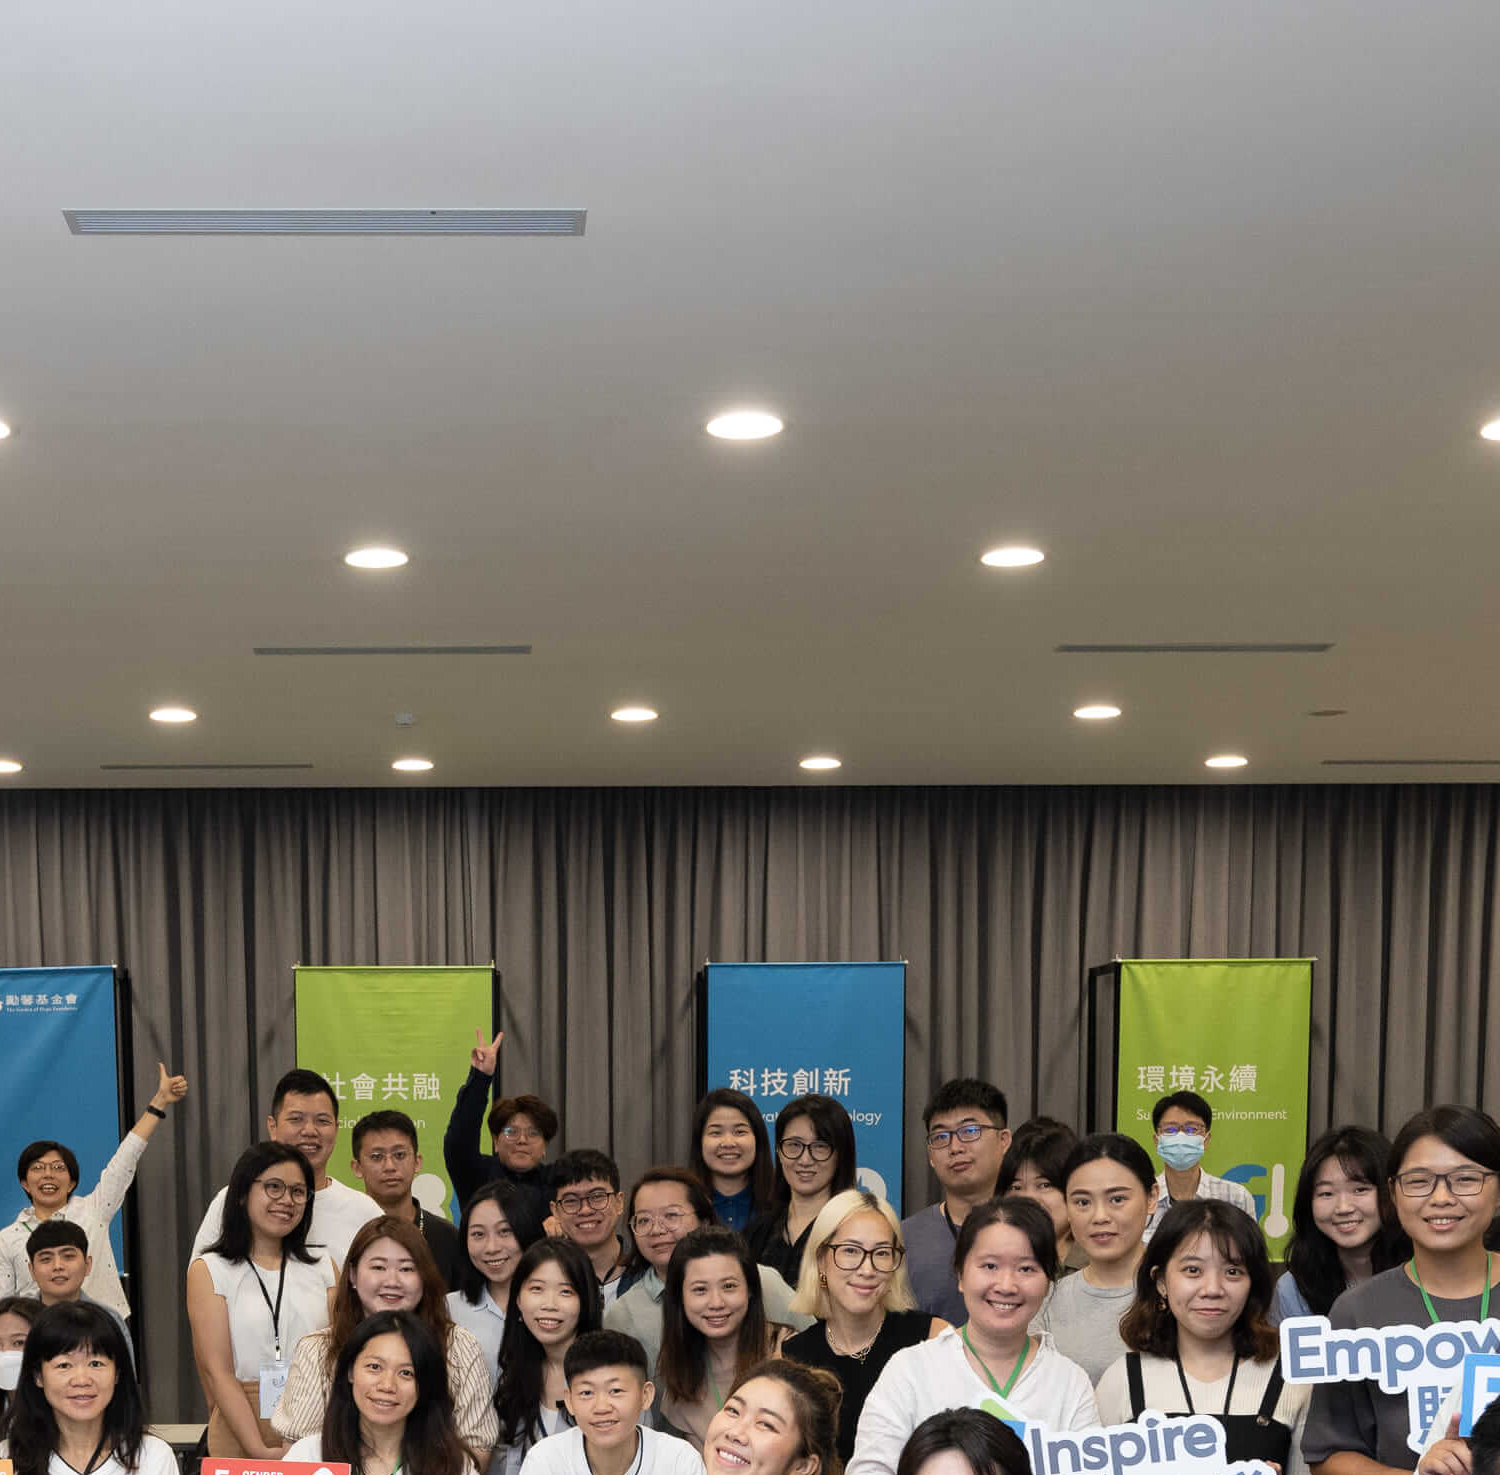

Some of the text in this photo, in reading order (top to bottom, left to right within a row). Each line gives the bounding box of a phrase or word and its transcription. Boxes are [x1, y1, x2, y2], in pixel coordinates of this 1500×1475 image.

[729, 1067, 851, 1097] 科技創新
[1137, 1064, 1257, 1092] 環境永續
